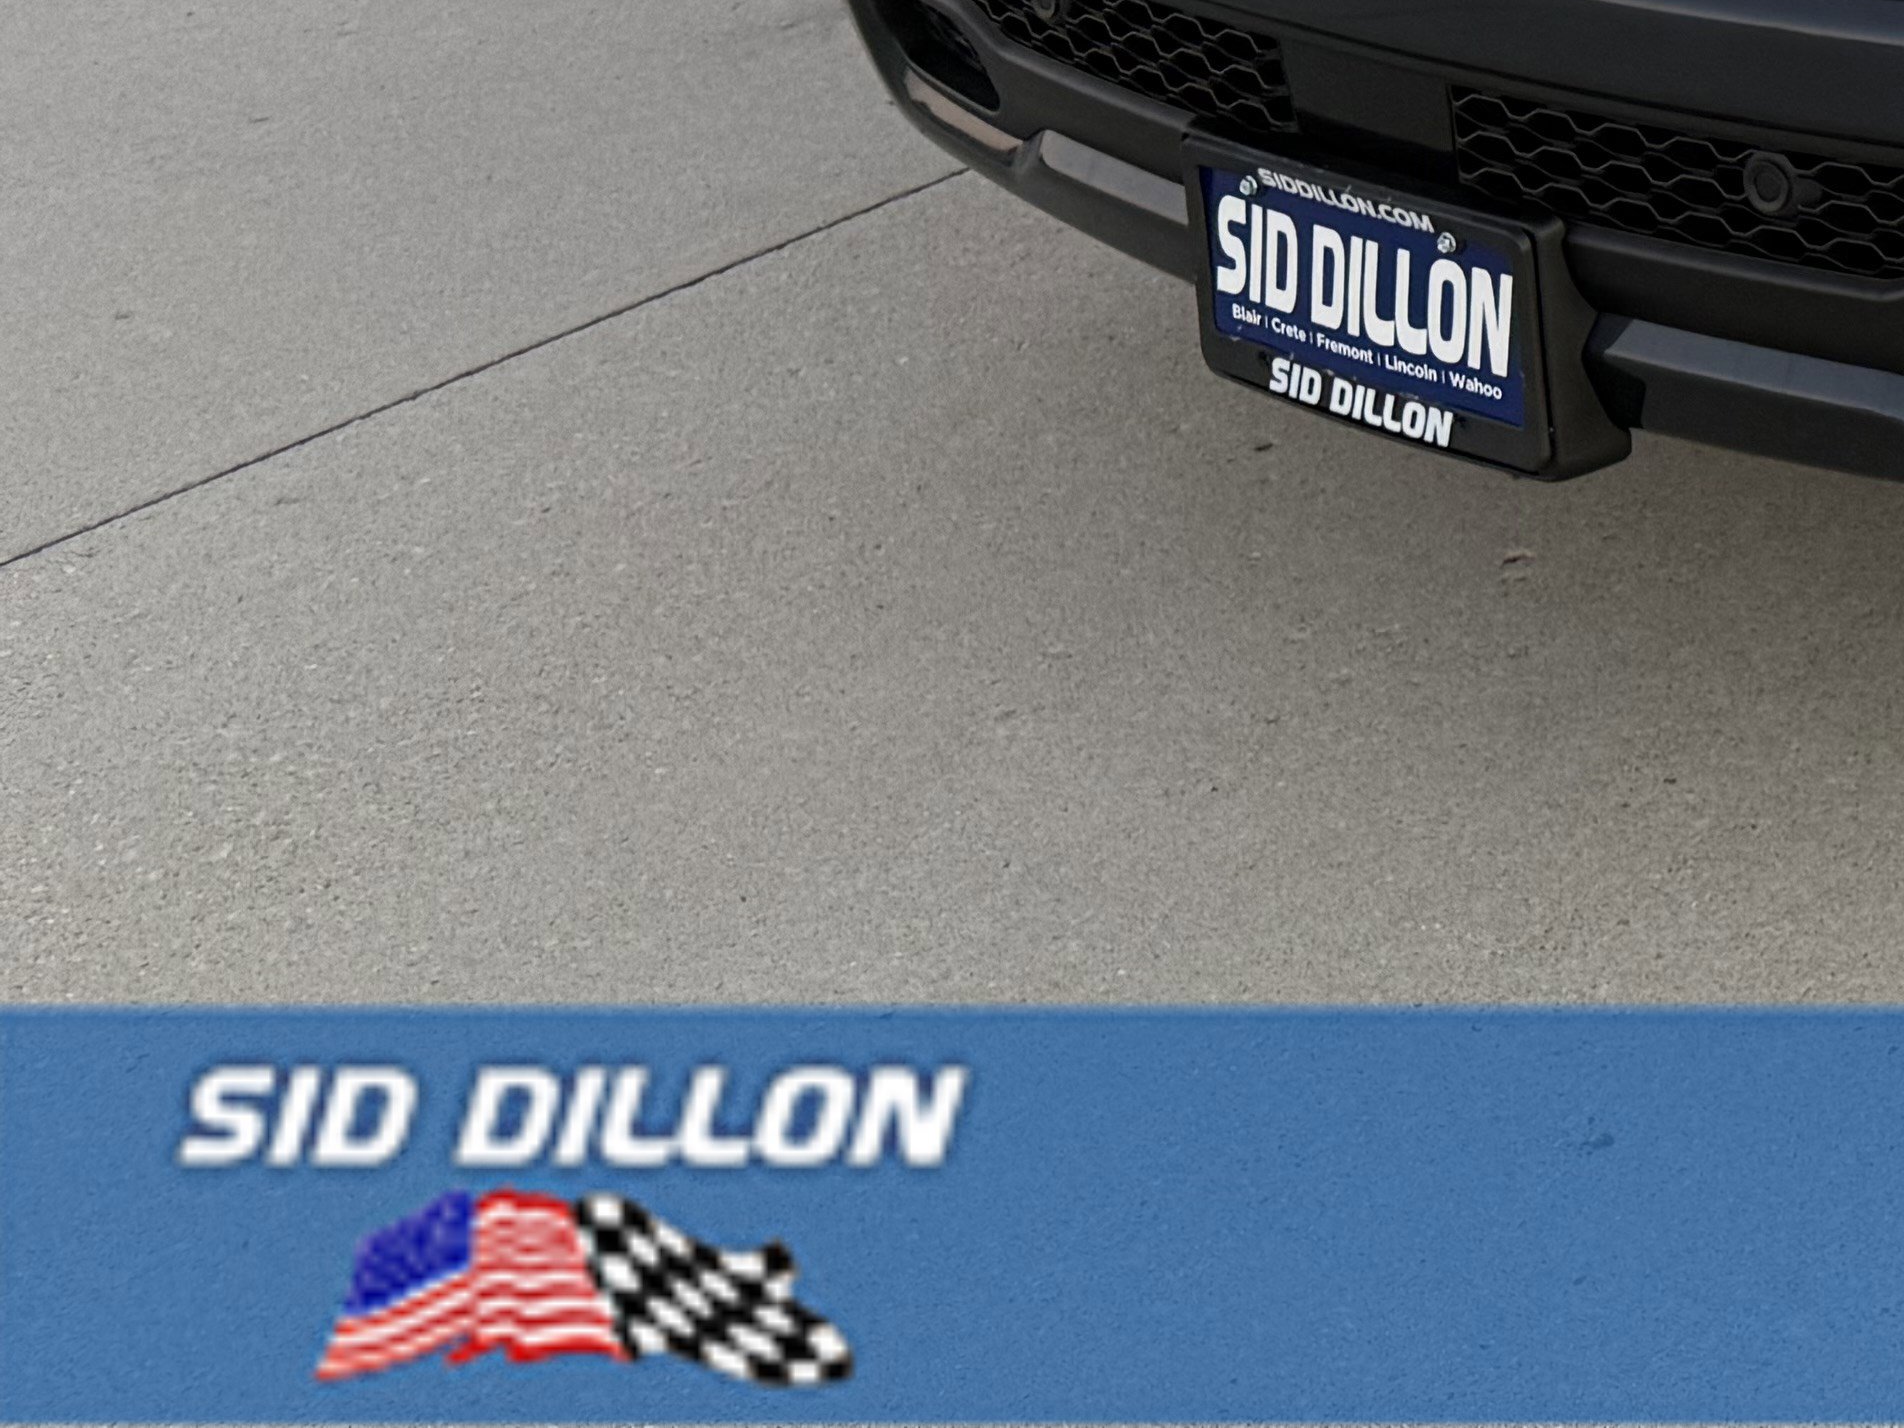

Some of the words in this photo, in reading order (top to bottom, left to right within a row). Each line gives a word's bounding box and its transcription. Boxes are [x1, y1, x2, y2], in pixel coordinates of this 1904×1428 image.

[1257, 168, 1434, 233] SIDDILLON.COM
[1216, 194, 1298, 314] SID
[1310, 224, 1513, 377] DILLON
[1231, 303, 1262, 326] Blair
[1271, 318, 1307, 343] Crete
[1316, 333, 1374, 364] Fremont
[1384, 354, 1438, 383] Lincoln
[1449, 371, 1502, 400] Wahoo
[1269, 357, 1322, 405] SID
[1329, 381, 1453, 448] DILLON
